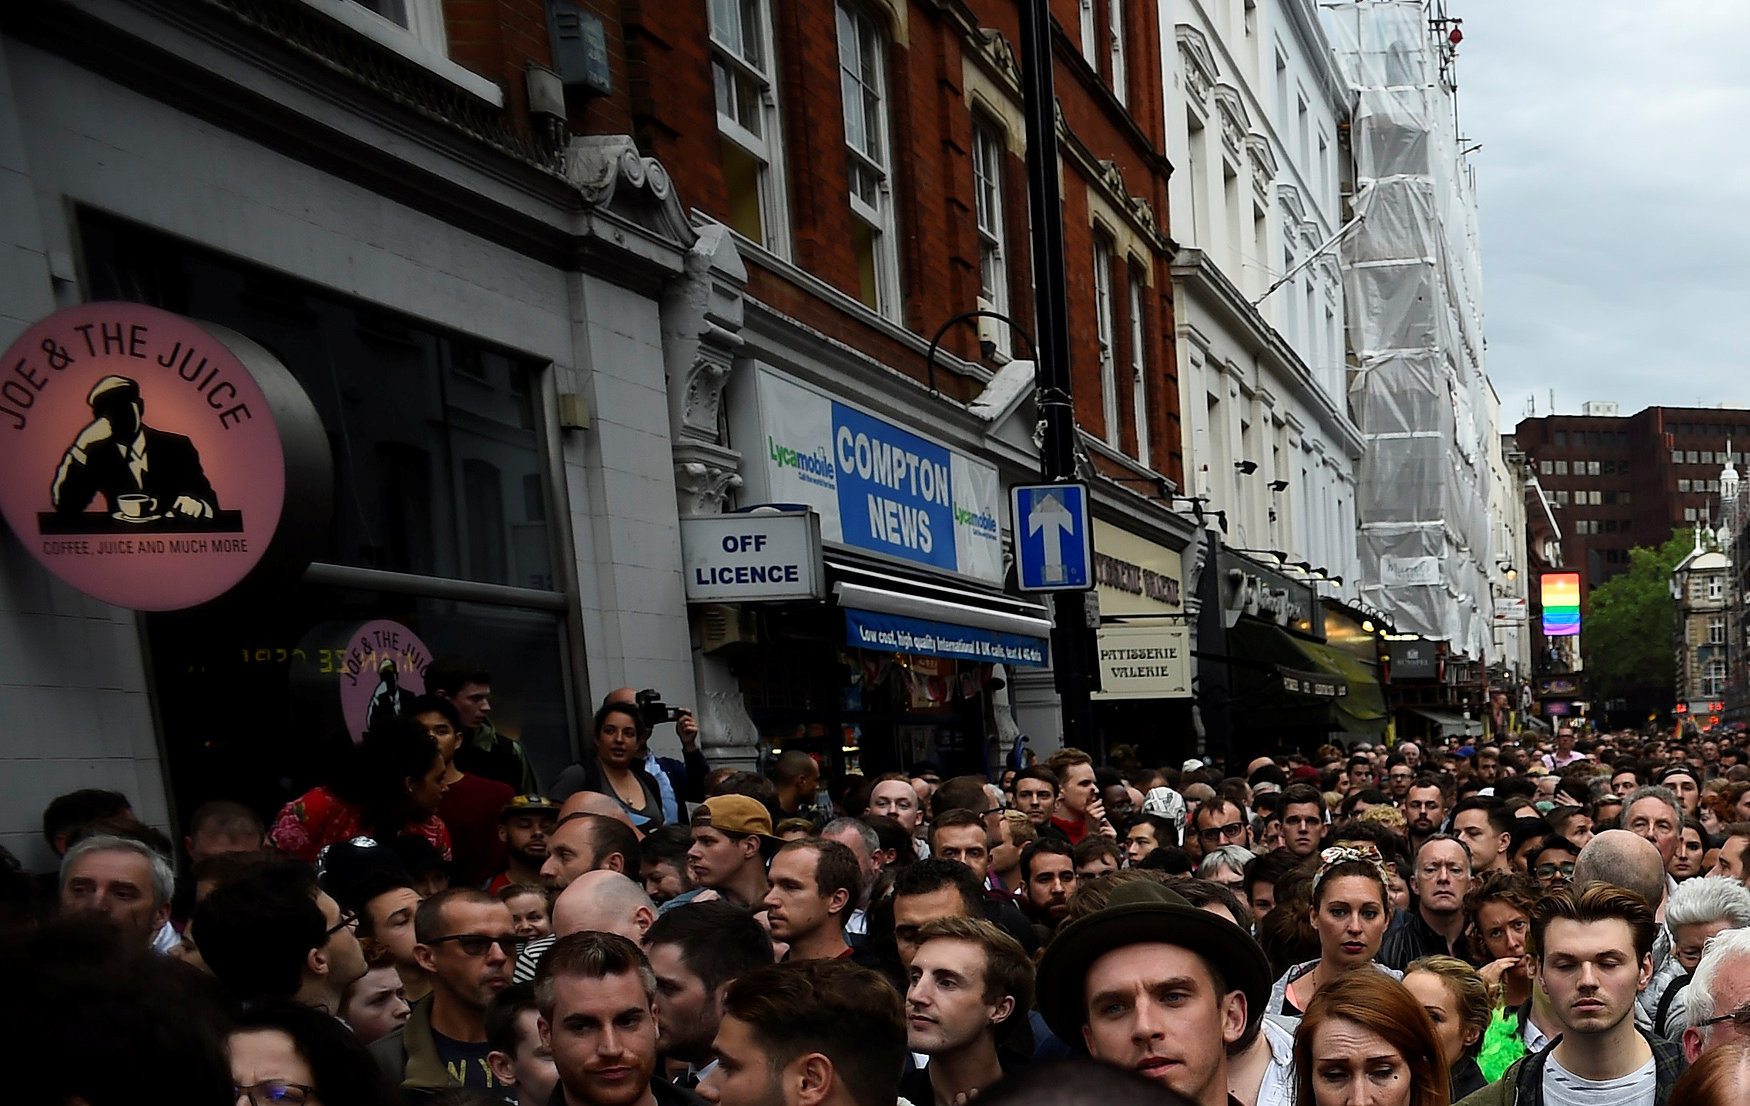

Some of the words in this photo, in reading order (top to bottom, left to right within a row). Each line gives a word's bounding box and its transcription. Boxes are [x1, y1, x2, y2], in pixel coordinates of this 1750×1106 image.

[0, 358, 49, 431] JOE
[41, 338, 75, 371] &
[74, 322, 149, 359] THE
[157, 341, 252, 431] JUICE
[768, 435, 834, 480] Lycamobile
[836, 425, 950, 508] COMPTON
[867, 493, 933, 554] NEWS
[43, 540, 94, 556] COFFEE,
[97, 540, 134, 555] JUICE
[138, 540, 164, 554] AND
[169, 539, 208, 553] MUCH
[211, 538, 248, 553] MORE
[722, 534, 767, 553] OFF
[696, 564, 799, 585] LICENCE
[859, 624, 877, 643] Low
[878, 629, 898, 648] cost,
[897, 630, 914, 650] high
[914, 633, 937, 654] quality
[936, 635, 975, 655] International
[1100, 647, 1178, 661] PATISSERIE
[345, 647, 362, 687] JOE
[361, 636, 373, 655] &
[373, 630, 399, 651] THE
[1110, 665, 1169, 678] VALERIE
